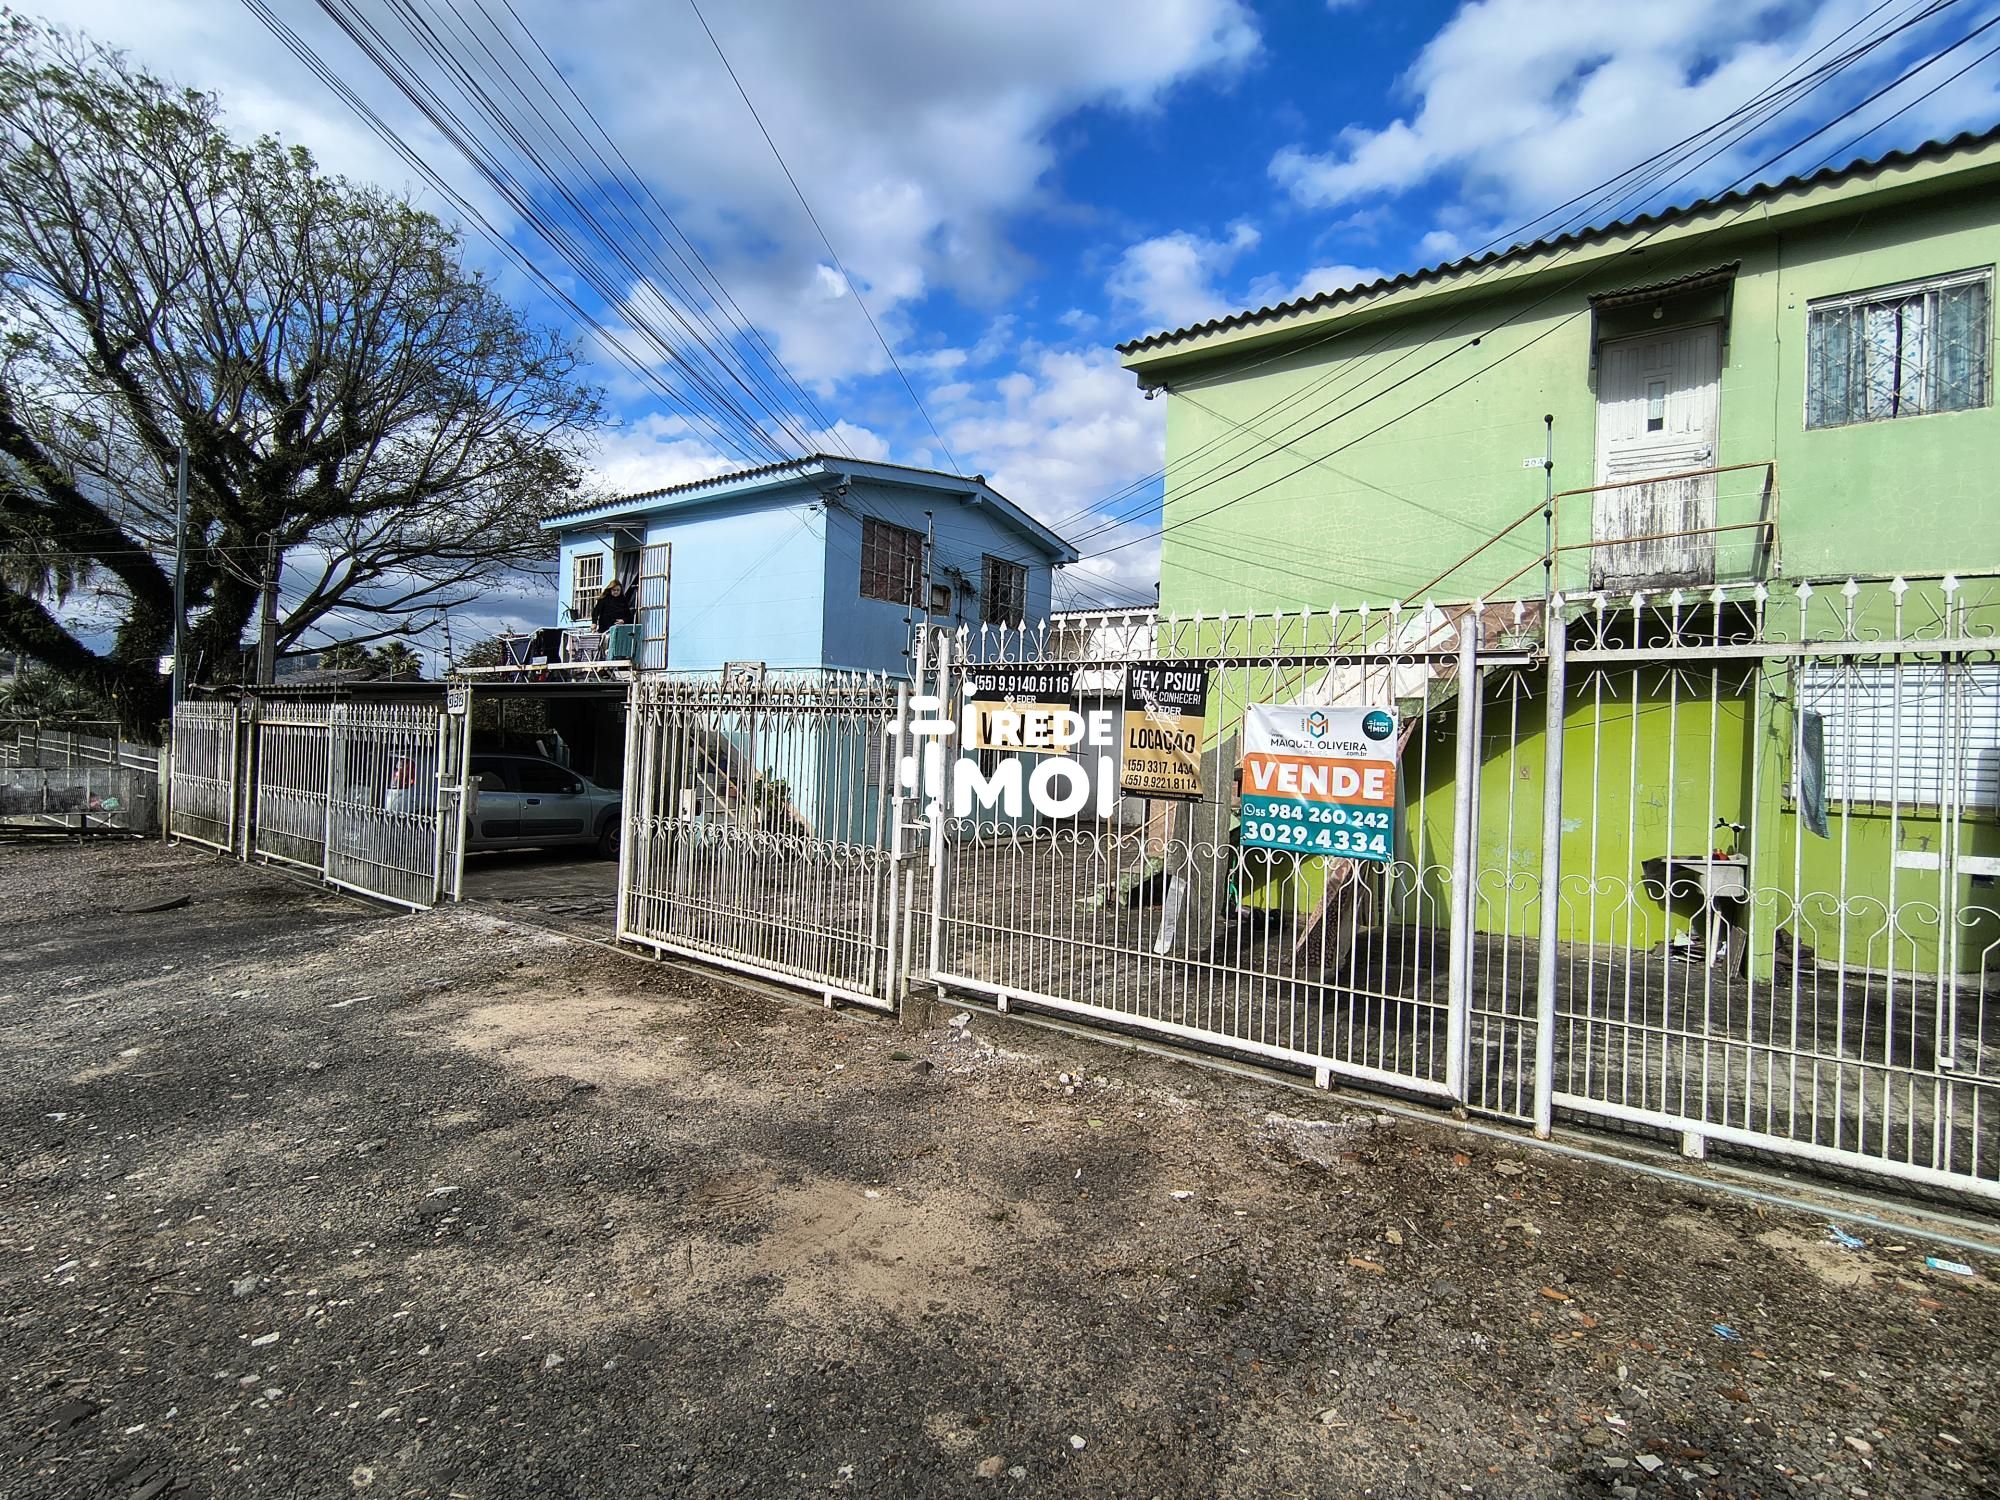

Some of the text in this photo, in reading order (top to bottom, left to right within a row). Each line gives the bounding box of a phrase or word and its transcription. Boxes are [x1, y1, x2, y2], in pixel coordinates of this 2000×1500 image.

[975, 675, 1070, 693] (55) 9.9140.6116
[1132, 669, 1202, 693] HEY, PSIU!
[1016, 694, 1037, 704] EDER
[1158, 691, 1201, 705] CONHECER!
[1158, 705, 1182, 716] EDER
[1130, 727, 1196, 754] LOCAÇÃO
[1317, 741, 1368, 751] OLIVEIRA
[1128, 759, 1194, 775] (55) 3317.1434
[1125, 774, 1197, 790] (55) 9.9221.8114
[1250, 760, 1385, 800] VENDE
[1255, 803, 1389, 829] 55 984 260 242
[1245, 820, 1387, 854] 3029.4334
